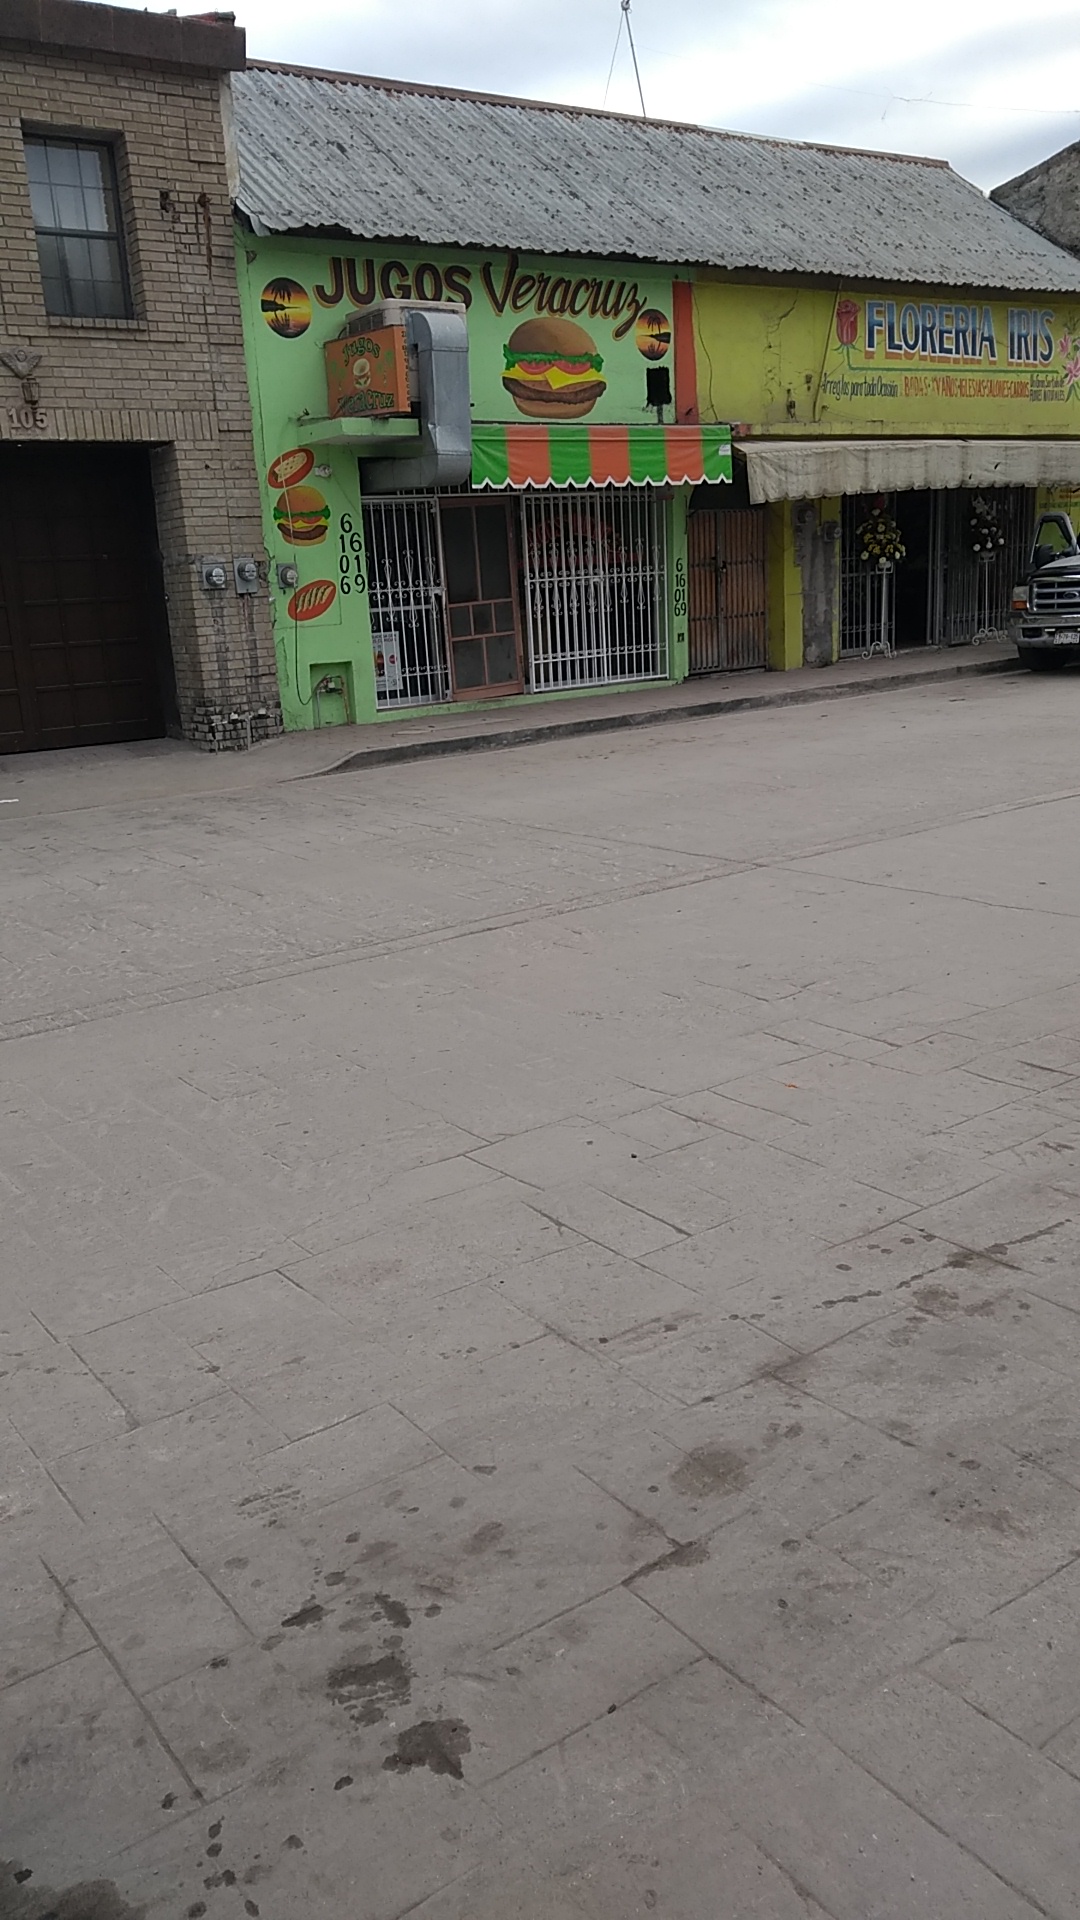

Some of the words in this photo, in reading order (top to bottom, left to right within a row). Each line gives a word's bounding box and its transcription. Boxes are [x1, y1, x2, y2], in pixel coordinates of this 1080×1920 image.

[314, 256, 472, 310] JUGOS
[480, 252, 647, 340] Veracruz
[865, 300, 997, 363] FLORERIA
[1008, 307, 1055, 366] IRIS
[8, 407, 48, 429] 105
[340, 512, 353, 534] 6
[339, 532, 362, 553] 16
[339, 554, 361, 574] 01
[675, 557, 683, 573] 6
[340, 573, 366, 595] 69
[675, 573, 686, 588] 16
[674, 588, 685, 603] 01
[674, 601, 687, 617] 69
